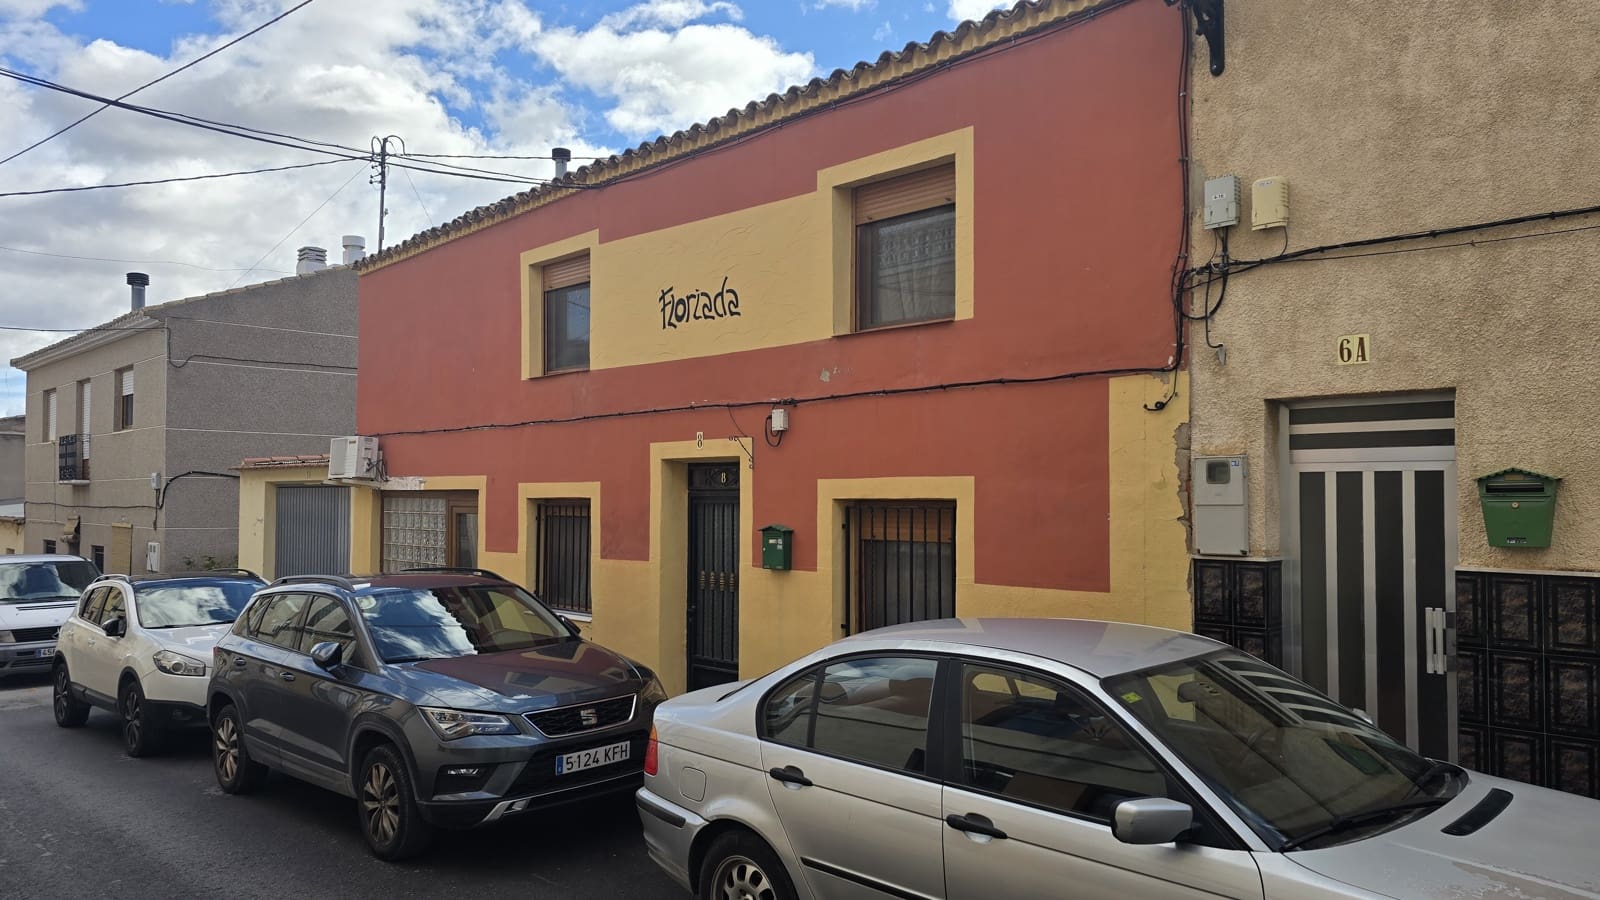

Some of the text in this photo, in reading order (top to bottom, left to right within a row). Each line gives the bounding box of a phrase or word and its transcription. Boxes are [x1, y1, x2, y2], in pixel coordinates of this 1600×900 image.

[659, 276, 741, 330] Floriada
[1339, 336, 1367, 363] 6A
[697, 433, 703, 449] 8
[566, 743, 628, 771] 5124 KFH
